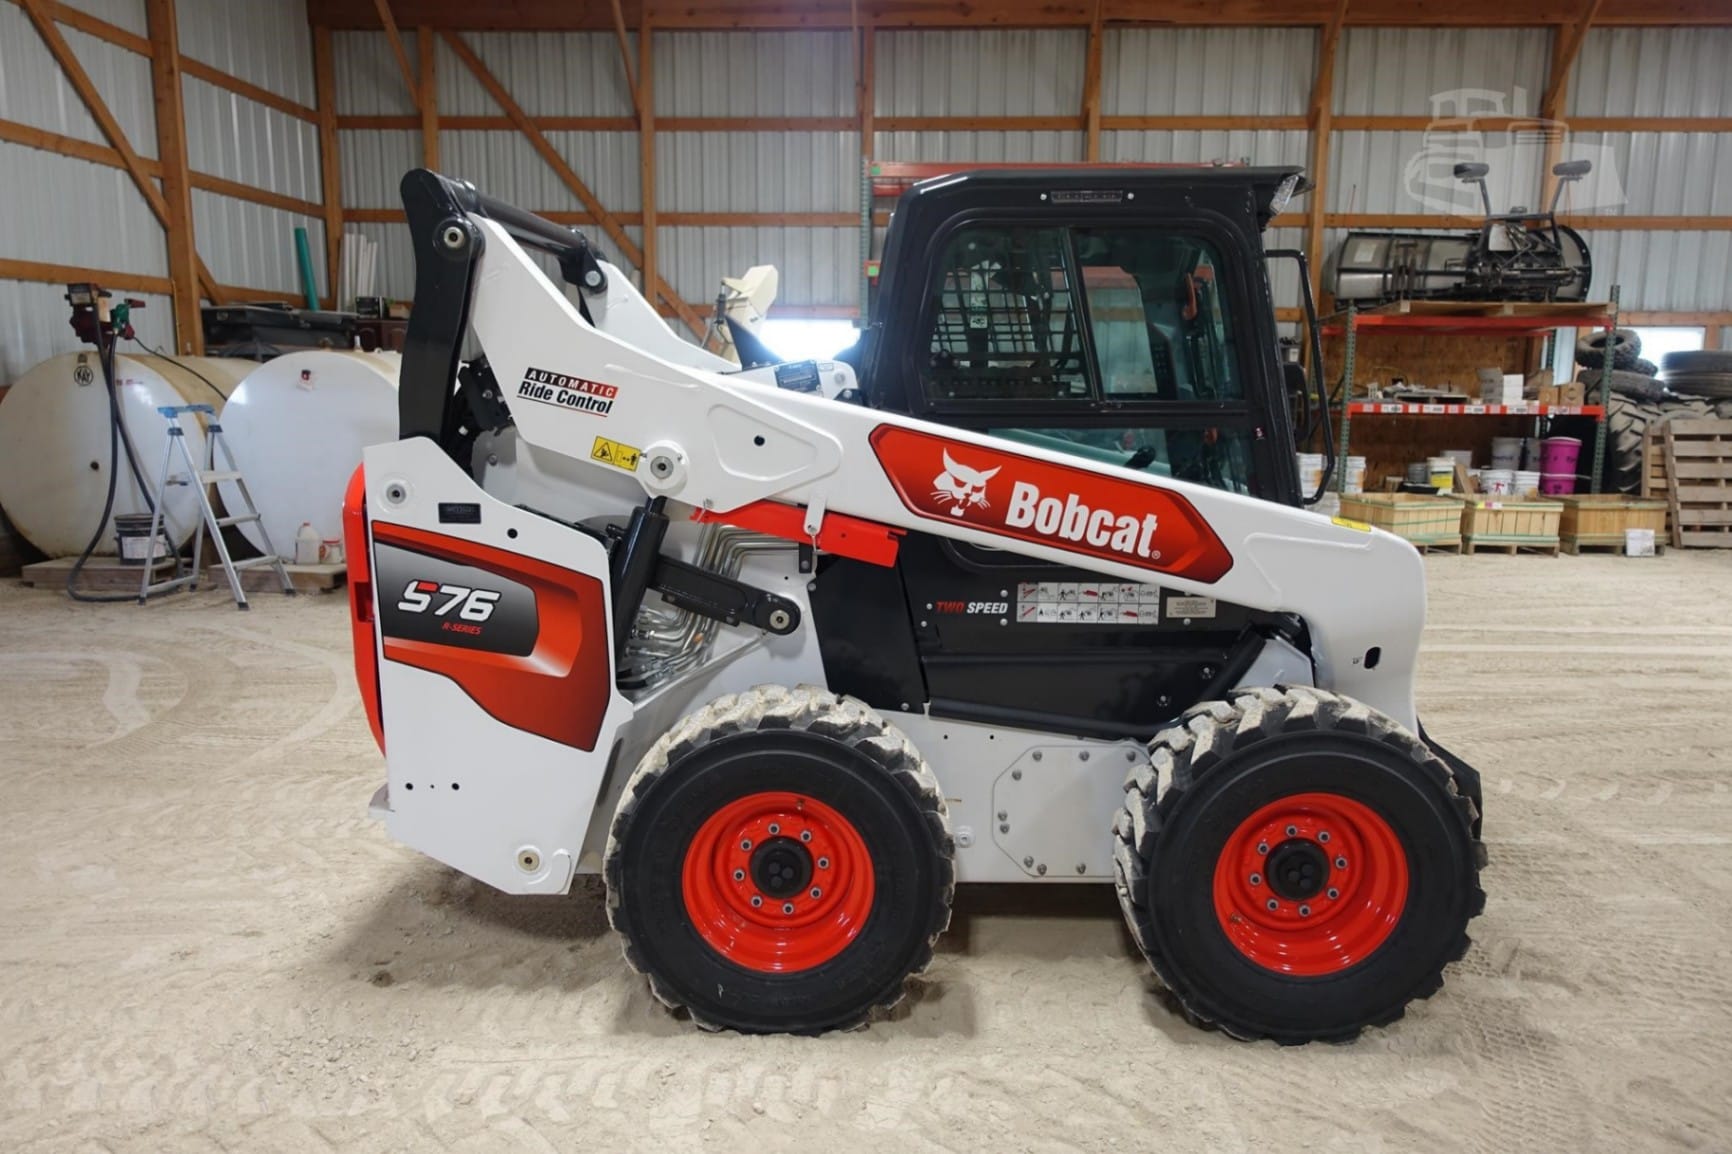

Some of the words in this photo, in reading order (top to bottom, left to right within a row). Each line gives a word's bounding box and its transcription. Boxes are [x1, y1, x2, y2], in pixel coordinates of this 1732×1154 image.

[518, 381, 552, 401] Ride
[556, 390, 614, 414] Control
[528, 370, 615, 397] AUTOMATIC
[1005, 481, 1158, 558] Bobcat
[397, 579, 501, 622] S76
[935, 601, 965, 614] TWO
[967, 601, 1009, 614] SPEED
[442, 622, 481, 635] R-SERIES
